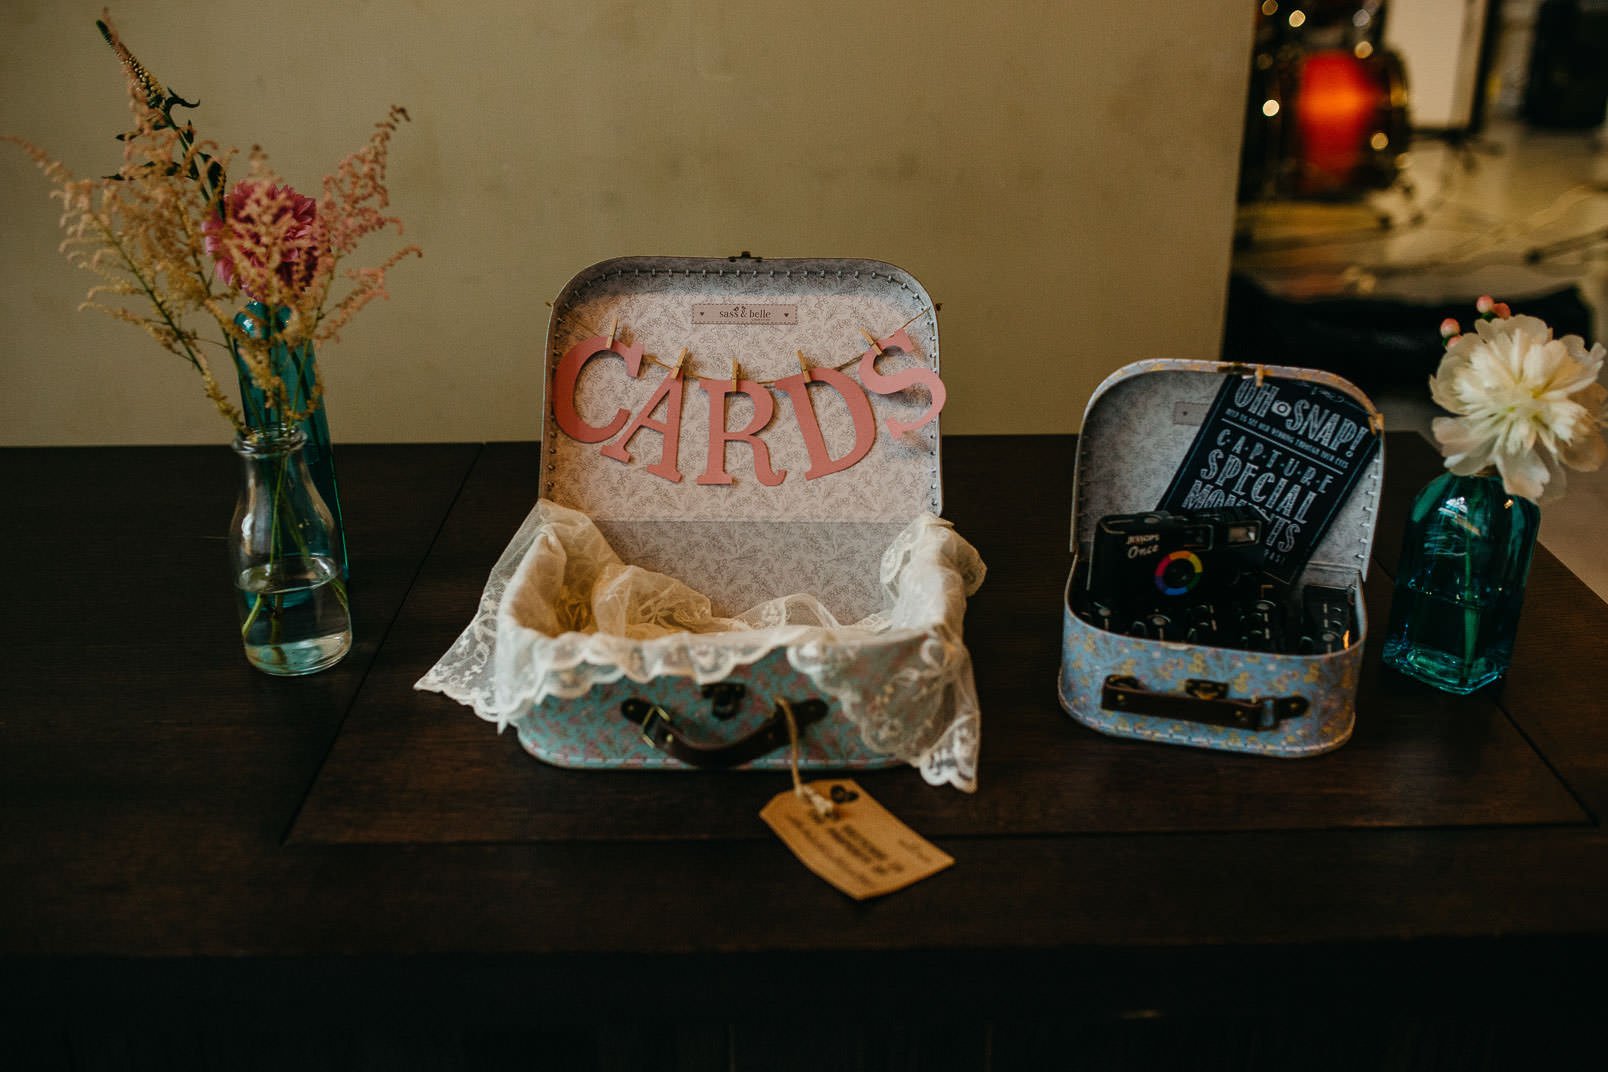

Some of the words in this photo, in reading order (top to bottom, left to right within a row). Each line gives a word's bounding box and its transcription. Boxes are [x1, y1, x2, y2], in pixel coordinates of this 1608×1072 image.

[719, 309, 739, 318] sass
[749, 308, 771, 318] belle
[552, 329, 946, 487] CARDS
[1234, 377, 1280, 417] OH
[1285, 399, 1369, 458] SNAP!
[1181, 480, 1301, 553] MOTS
[1200, 448, 1317, 524] SPECIAL
[1127, 544, 1161, 560] Once
